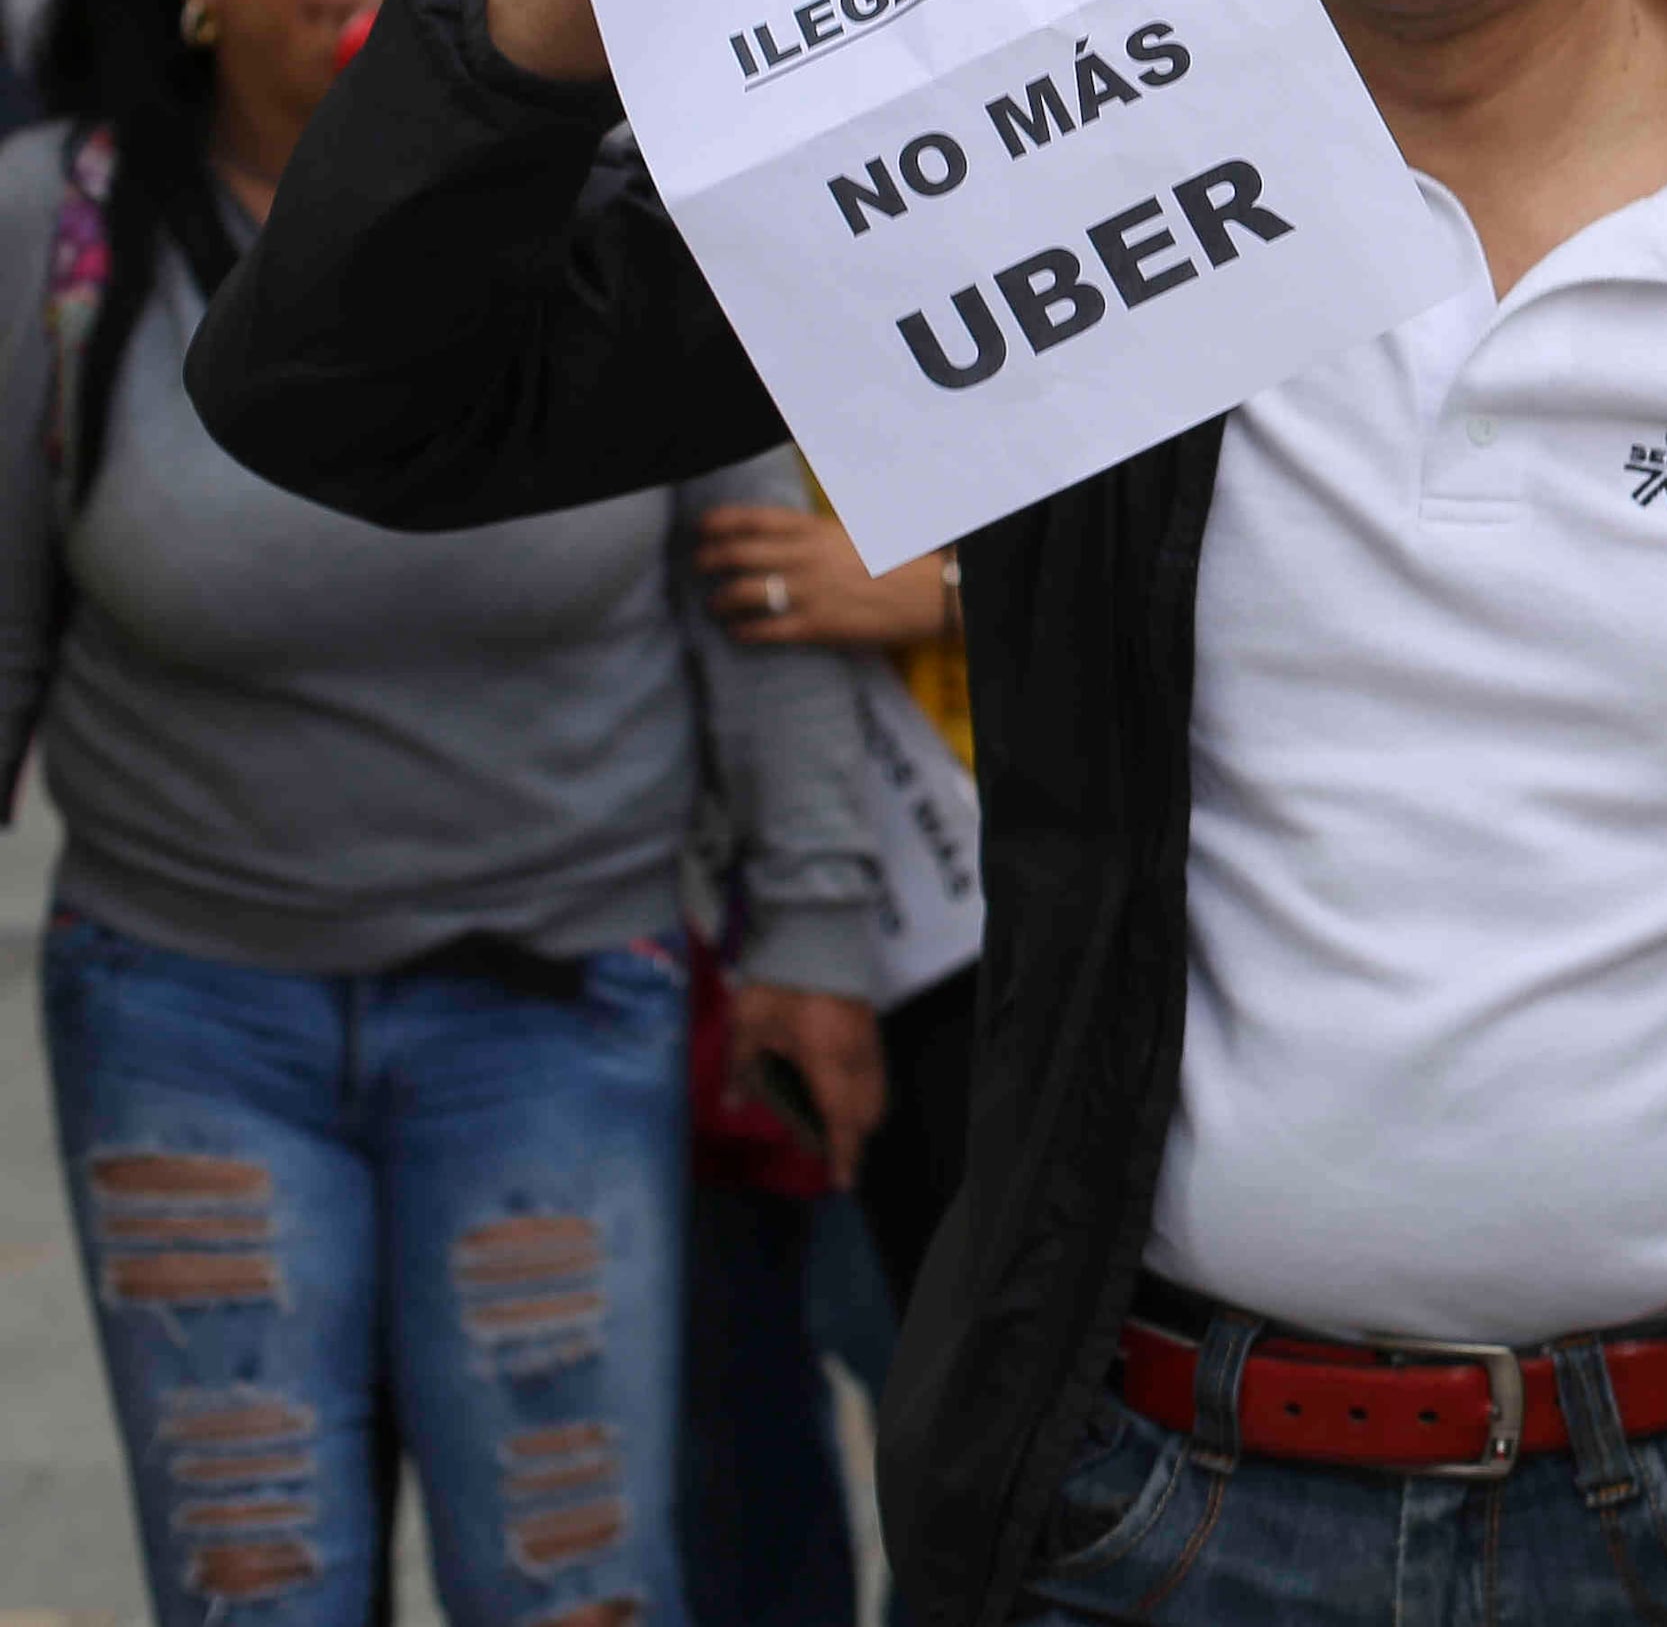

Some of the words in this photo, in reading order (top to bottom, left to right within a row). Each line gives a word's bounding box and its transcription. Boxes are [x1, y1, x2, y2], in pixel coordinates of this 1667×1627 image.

[826, 132, 968, 238] NO
[984, 22, 1191, 161] MÁS
[895, 159, 1296, 391] UBER
